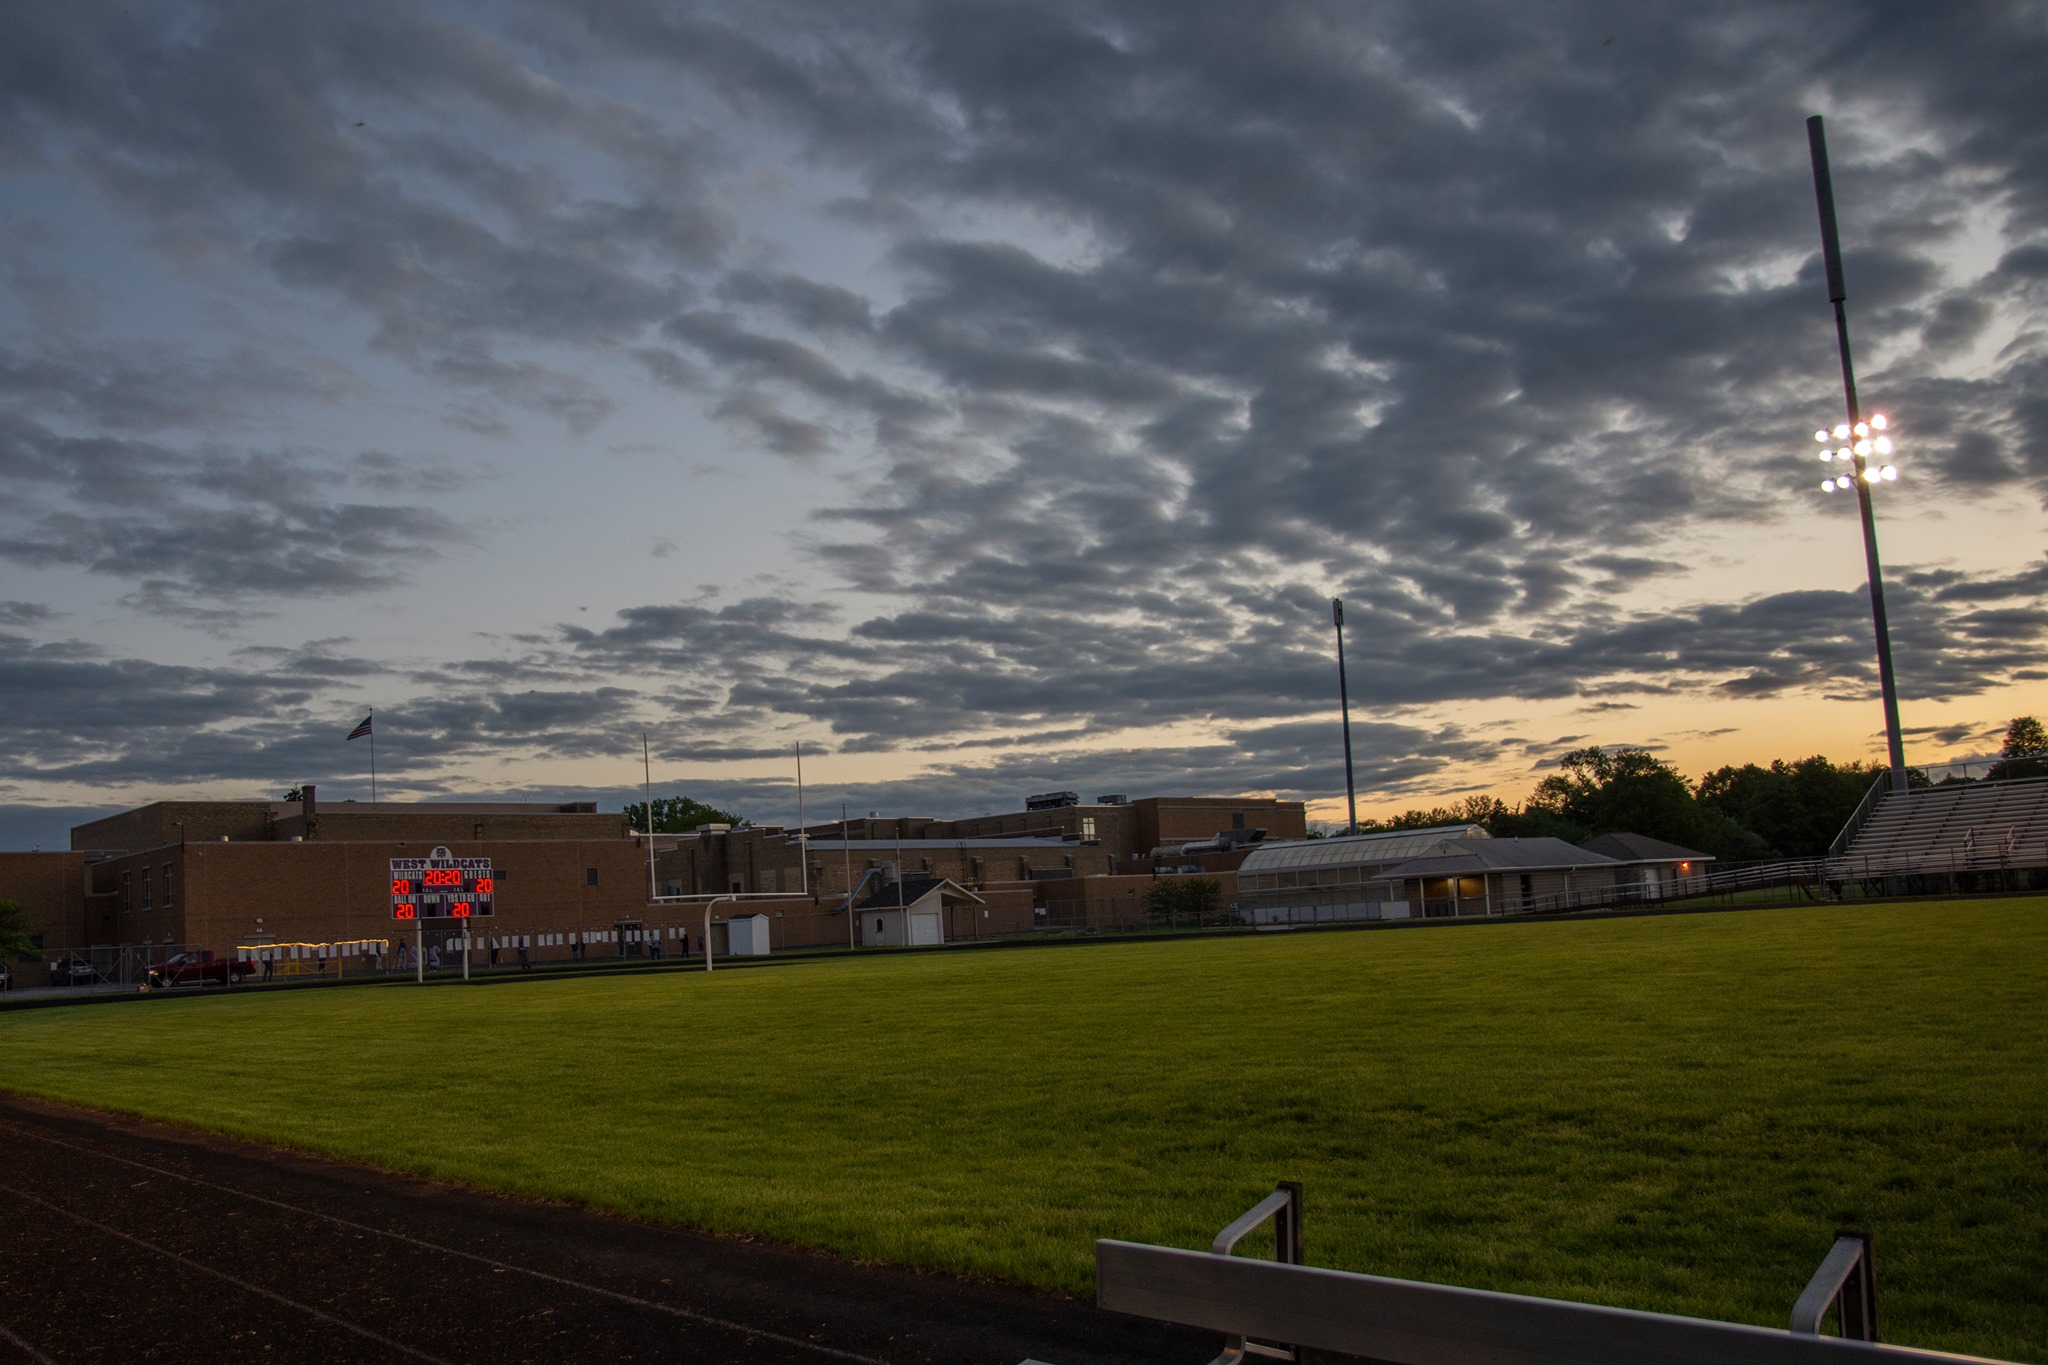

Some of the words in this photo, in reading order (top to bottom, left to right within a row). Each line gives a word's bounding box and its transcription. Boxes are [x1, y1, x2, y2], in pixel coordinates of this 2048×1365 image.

[392, 859, 426, 869] WEST
[430, 859, 490, 869] WILDCATS
[393, 871, 423, 880] WILDCATS
[425, 870, 461, 885] 20:20
[464, 870, 490, 879] GUESTS
[392, 880, 410, 894] 20
[476, 879, 492, 893] 20
[424, 894, 440, 903] DOWN
[396, 904, 414, 919] 20
[453, 902, 470, 917] 20
